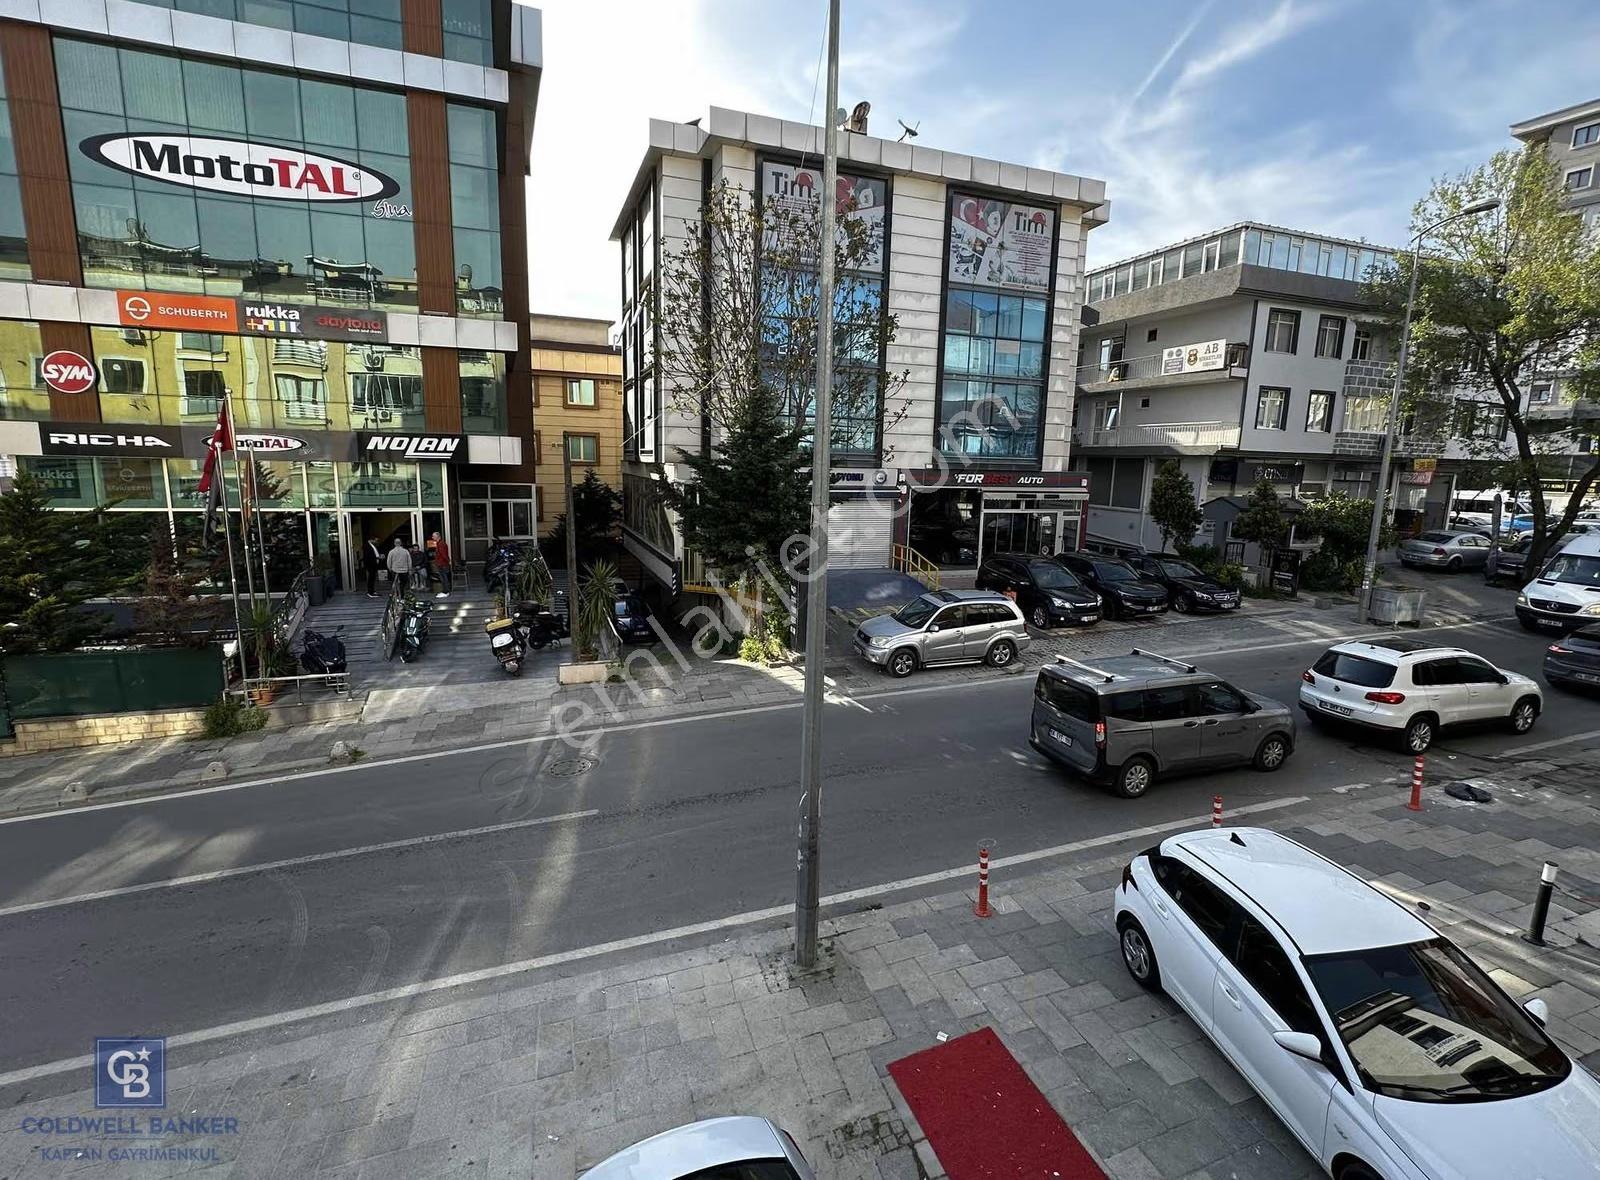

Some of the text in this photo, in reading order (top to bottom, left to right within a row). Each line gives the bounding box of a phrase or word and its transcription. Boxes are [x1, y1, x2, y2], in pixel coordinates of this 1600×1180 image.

[1014, 211, 1046, 235] Tim
[158, 306, 228, 319] SCHUBERTH
[246, 305, 300, 320] rukka
[1204, 342, 1219, 354] AB
[44, 364, 92, 383] SYM
[49, 433, 172, 447] RICHA
[366, 436, 459, 459] NOLAN
